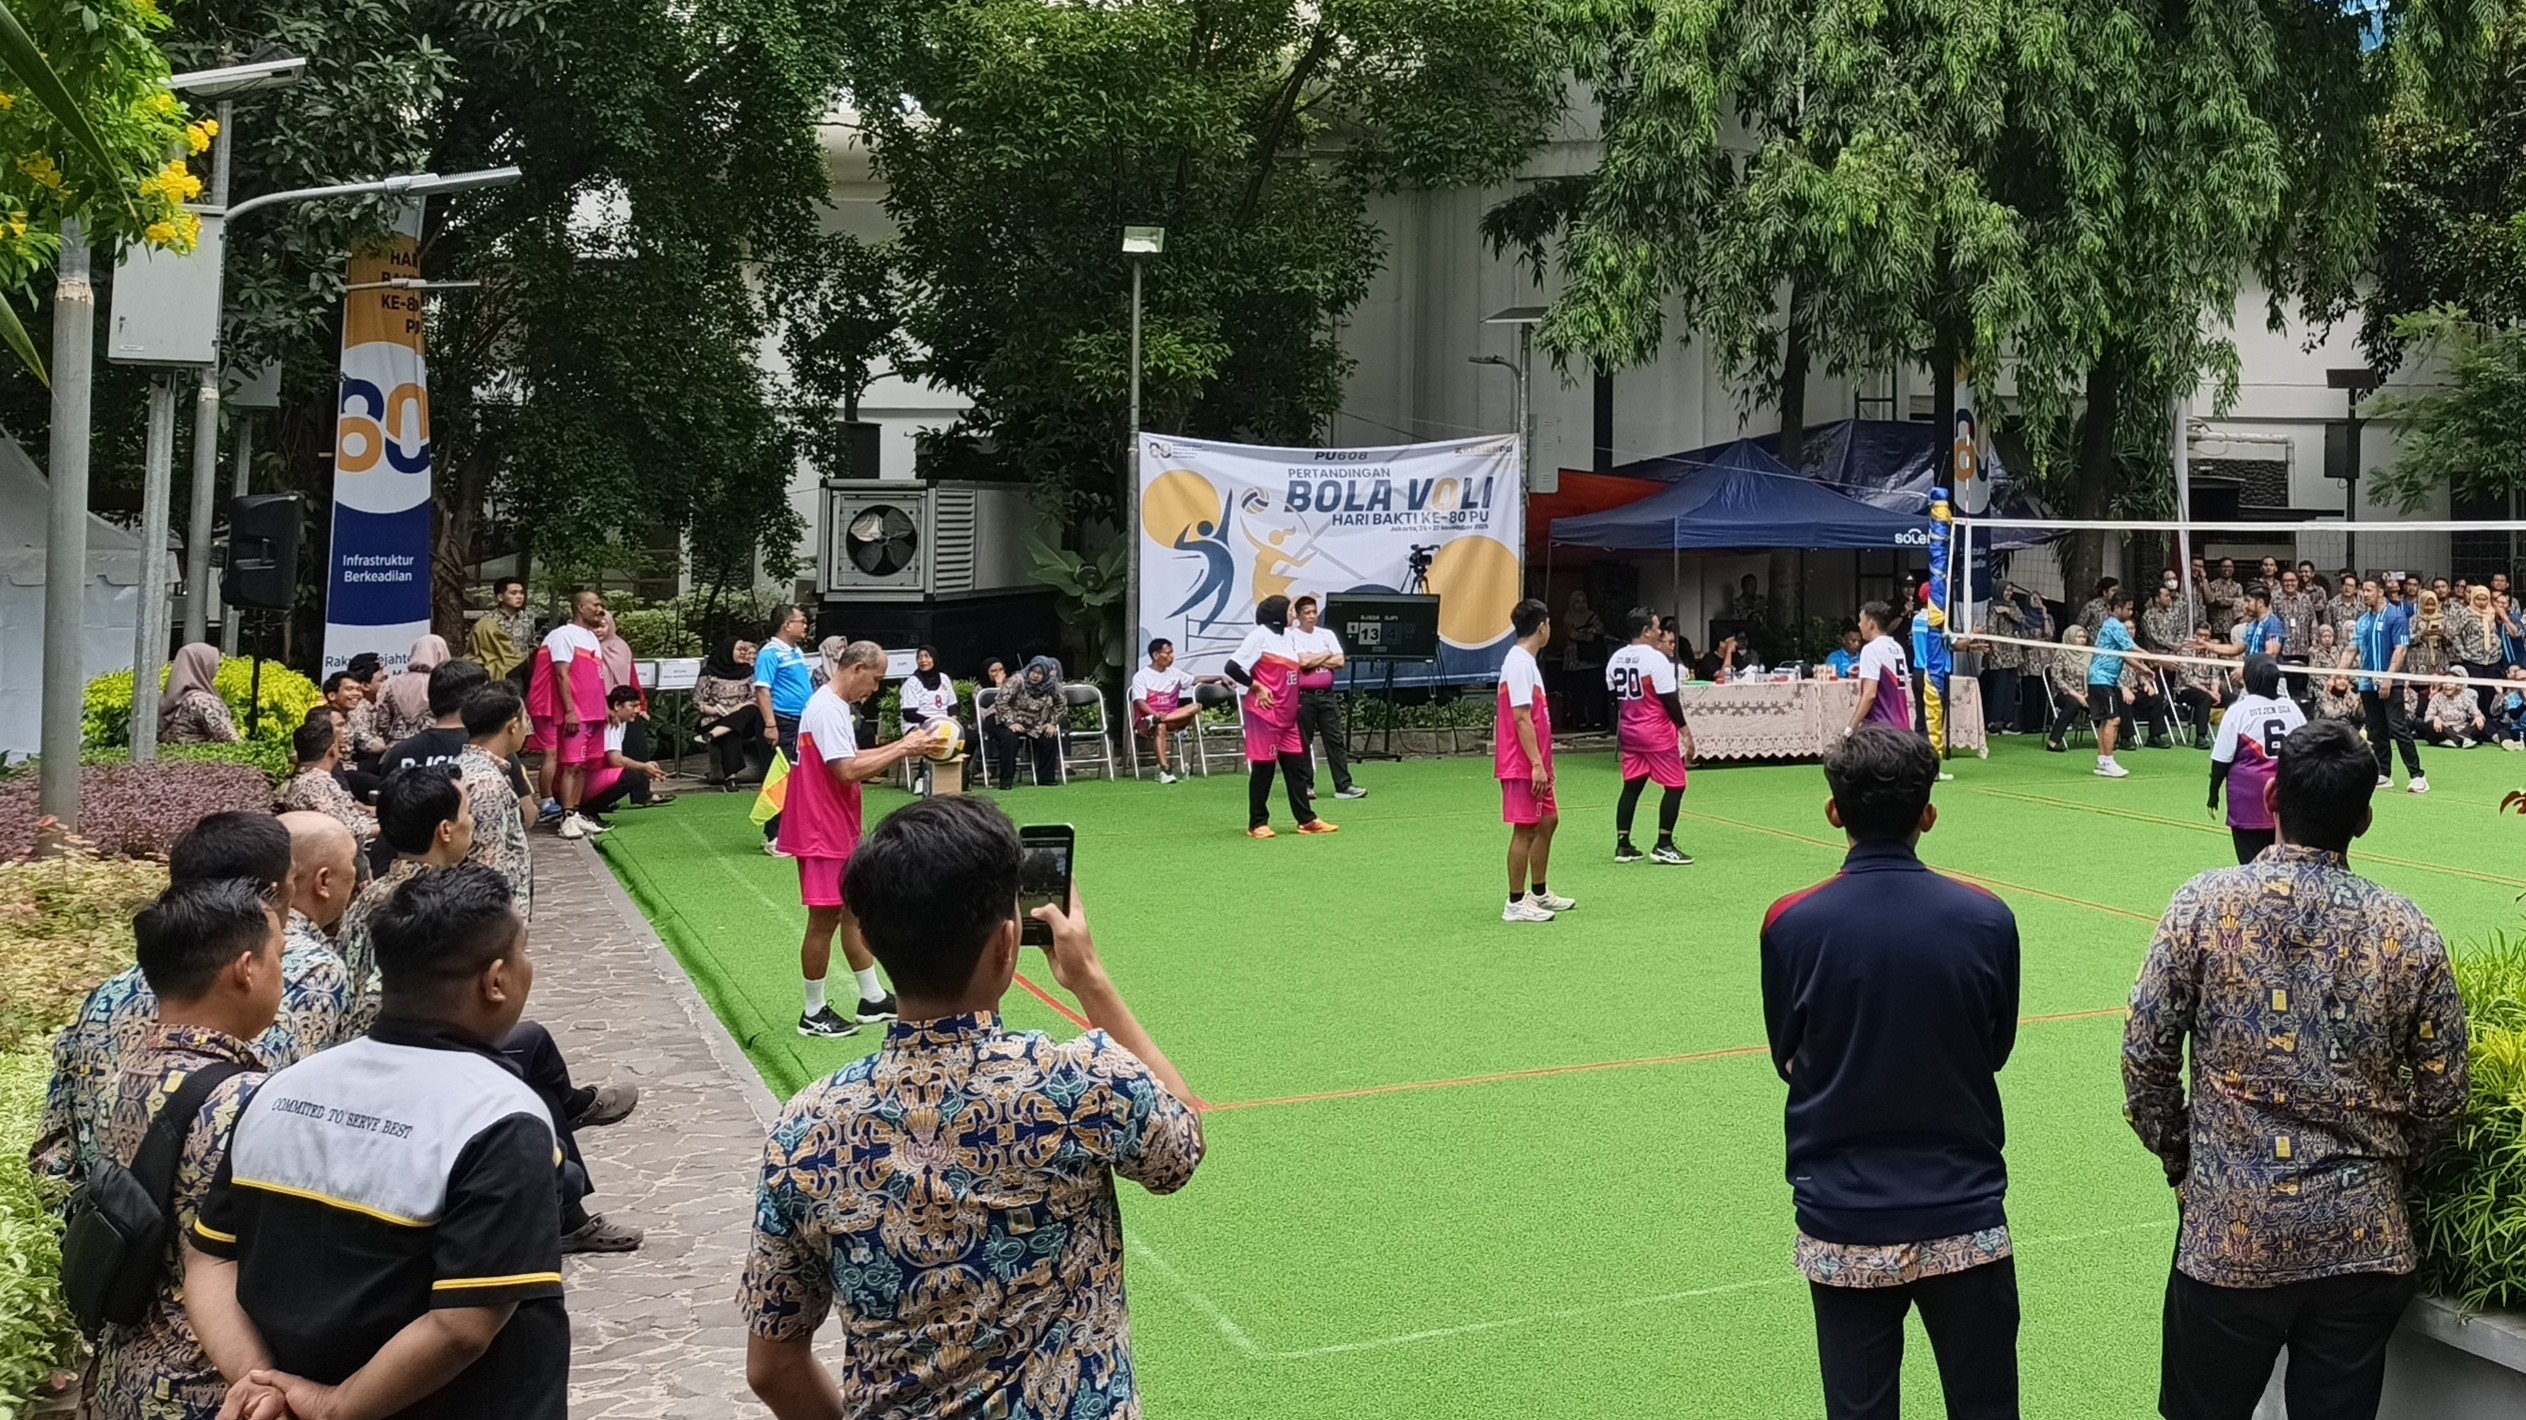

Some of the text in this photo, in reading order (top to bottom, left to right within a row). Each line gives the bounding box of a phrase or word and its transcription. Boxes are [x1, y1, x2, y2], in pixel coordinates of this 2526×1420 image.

[1314, 451, 1368, 461] PU608
[1288, 468, 1391, 479] PERTANDINGAN
[1284, 476, 1494, 512] BOLA VOLI
[1332, 510, 1489, 526] HARI BAKTI KE-80 PU
[342, 554, 414, 566] Infrastruktur
[344, 570, 413, 582] Berkeadilan
[1361, 628, 1379, 640] 13
[1612, 667, 1643, 700] 20
[2262, 718, 2286, 759] 6
[271, 1097, 413, 1139] COMMITED TO SERVE BEST
